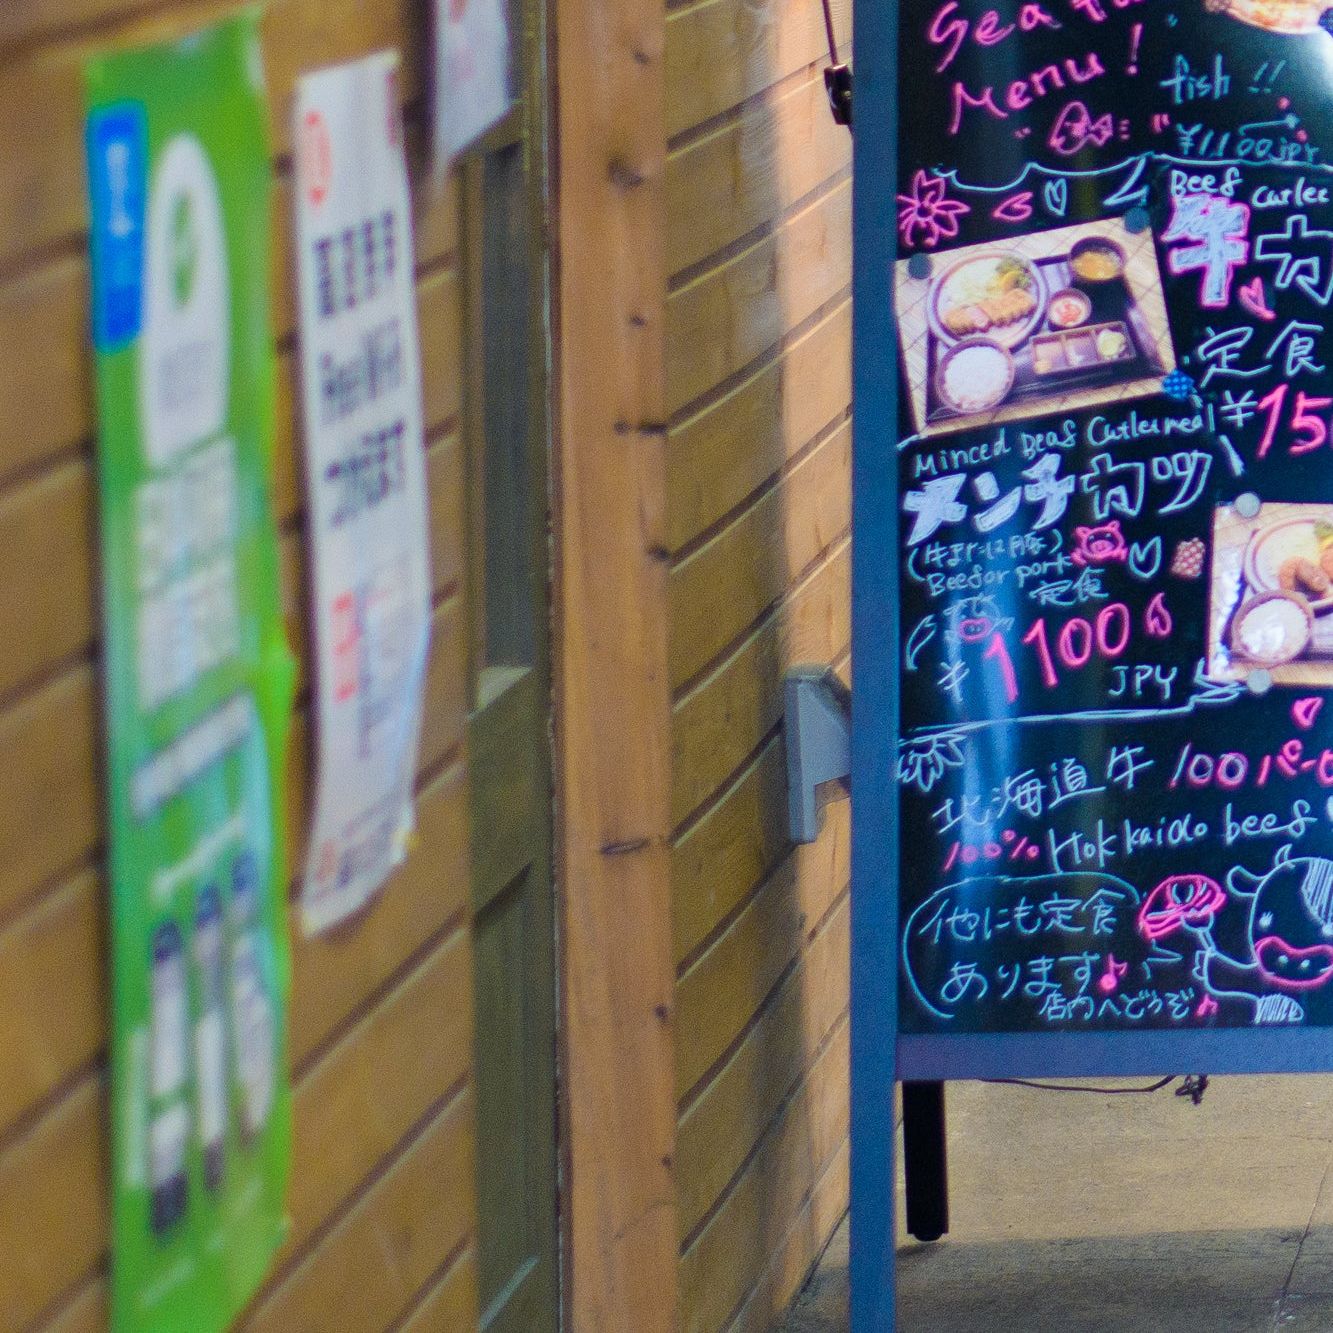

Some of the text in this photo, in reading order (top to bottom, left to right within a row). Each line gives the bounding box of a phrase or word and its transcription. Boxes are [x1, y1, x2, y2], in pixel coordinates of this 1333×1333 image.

[1169, 166, 1244, 198] Beef
[1198, 318, 1327, 389] 定食
[913, 428, 1012, 479] Minced
[902, 451, 1214, 548] メンチカツ
[1028, 566, 1110, 607] 定食
[1108, 664, 1179, 700] JPY
[931, 744, 1155, 834] 北海道牛
[943, 828, 1041, 872] 100%
[1050, 814, 1207, 872] Hokkaido
[919, 886, 1127, 947] 他にも定食
[1041, 985, 1197, 1022] 店内へどうぞ
